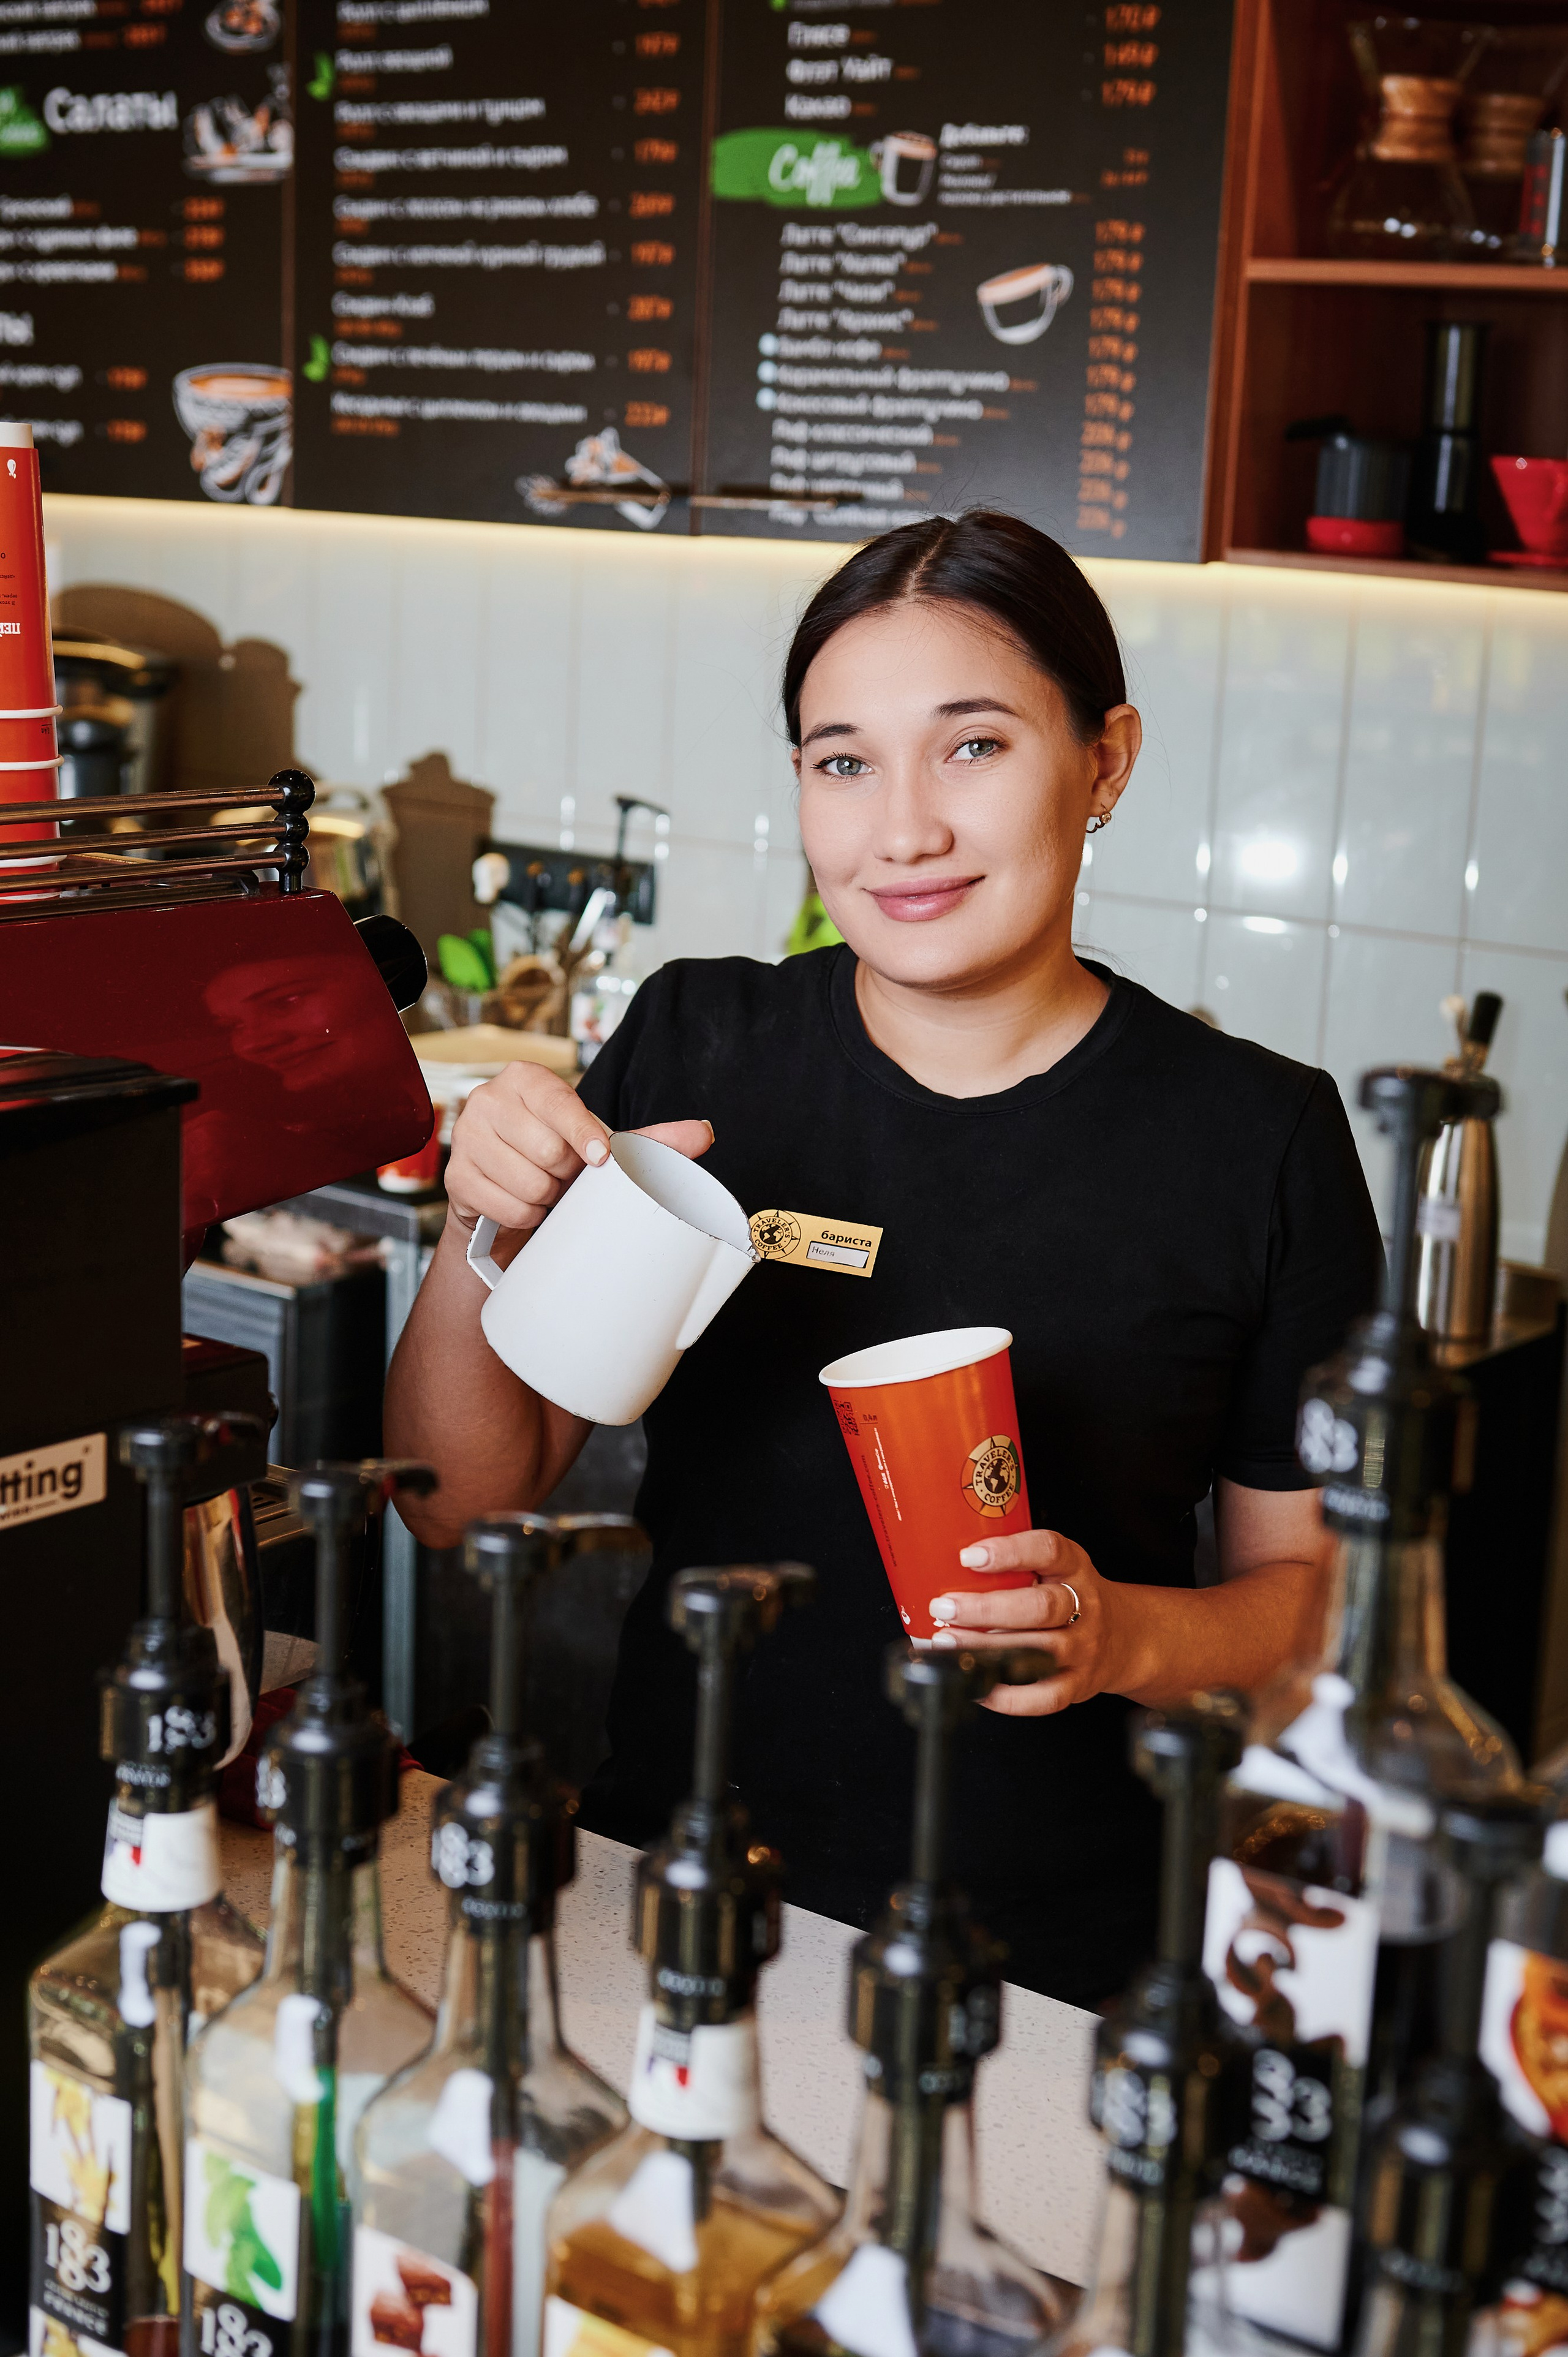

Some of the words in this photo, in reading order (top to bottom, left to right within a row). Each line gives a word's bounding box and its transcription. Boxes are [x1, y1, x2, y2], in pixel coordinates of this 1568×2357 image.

[753, 1218, 790, 1239] TRAVELER'S
[755, 1239, 783, 1251] COFFEE
[821, 1230, 872, 1248] бариста
[812, 1246, 835, 1258] Неля
[975, 1449, 1015, 1486] TRAVELER'S
[984, 1483, 1015, 1504] COFFEE
